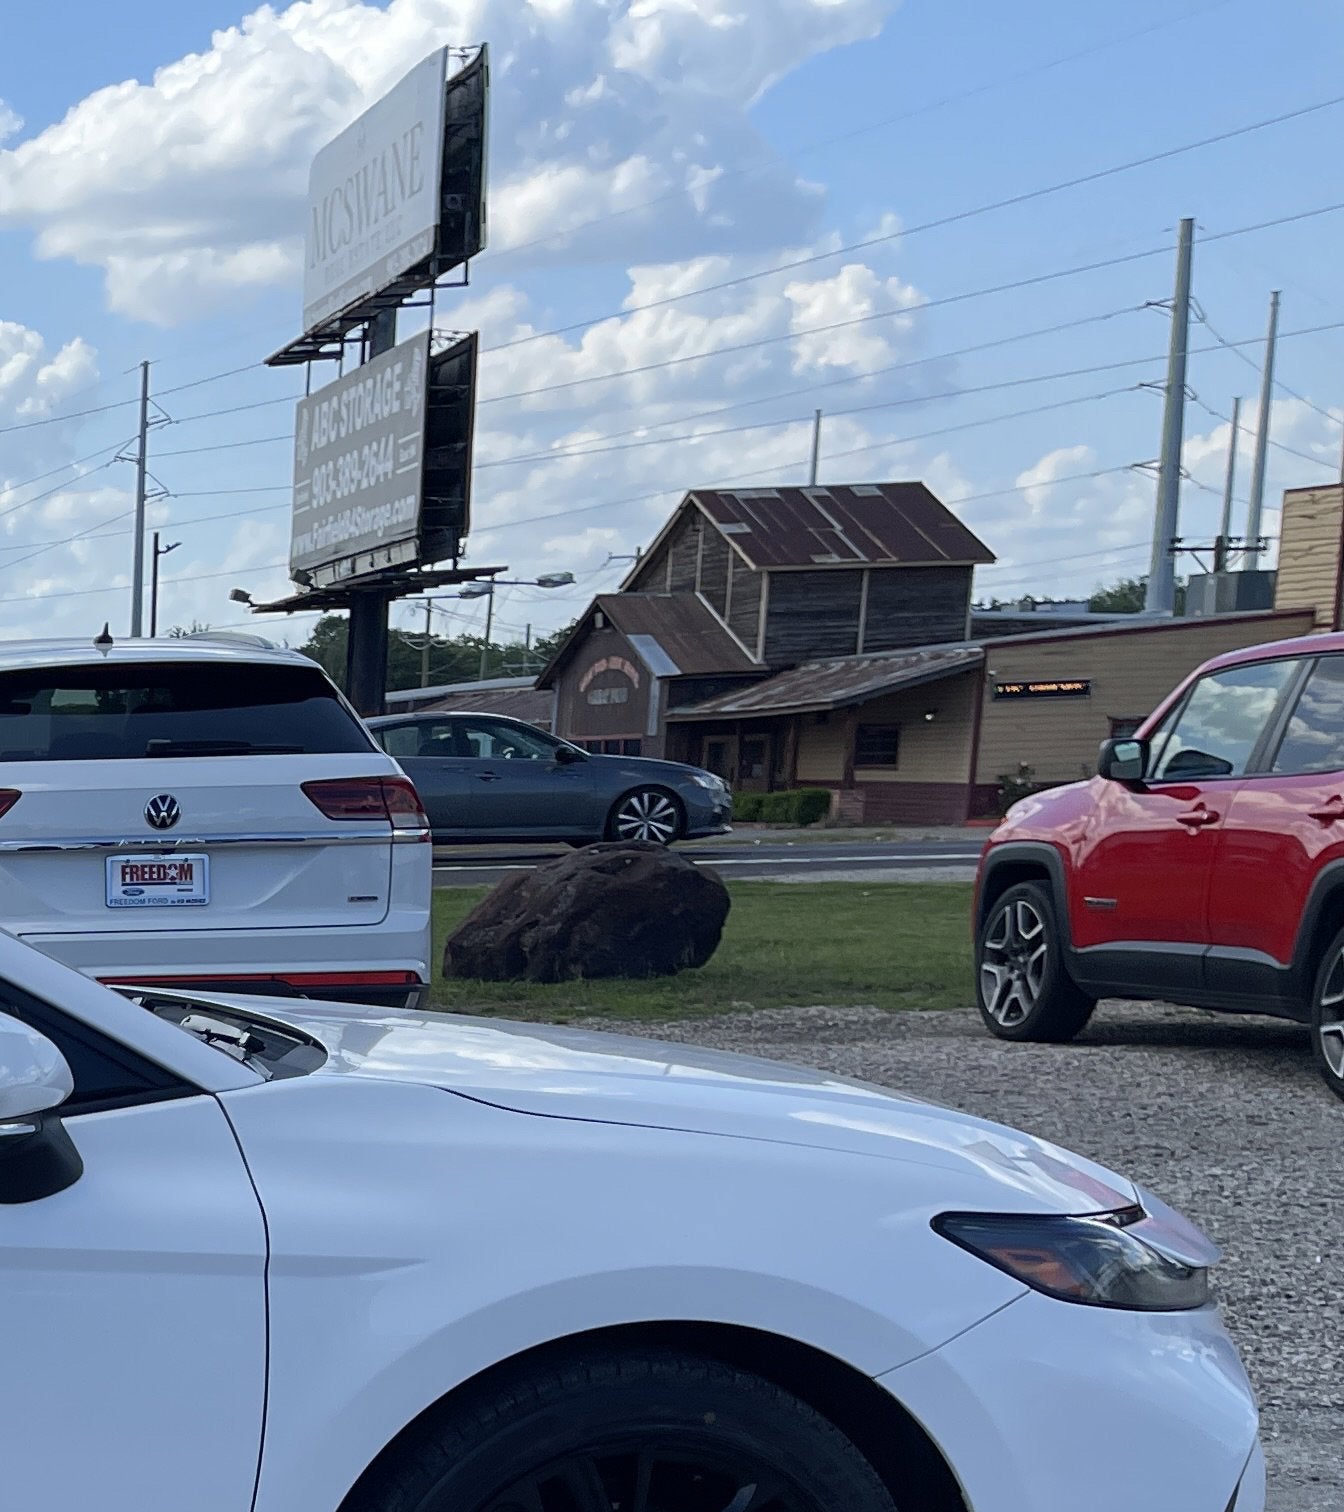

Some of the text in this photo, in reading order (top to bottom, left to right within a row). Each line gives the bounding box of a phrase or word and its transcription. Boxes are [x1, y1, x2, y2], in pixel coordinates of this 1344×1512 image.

[311, 121, 424, 269] MCSWANE
[310, 361, 403, 451] ABC STORAGE
[121, 863, 193, 882] FREEDOM
